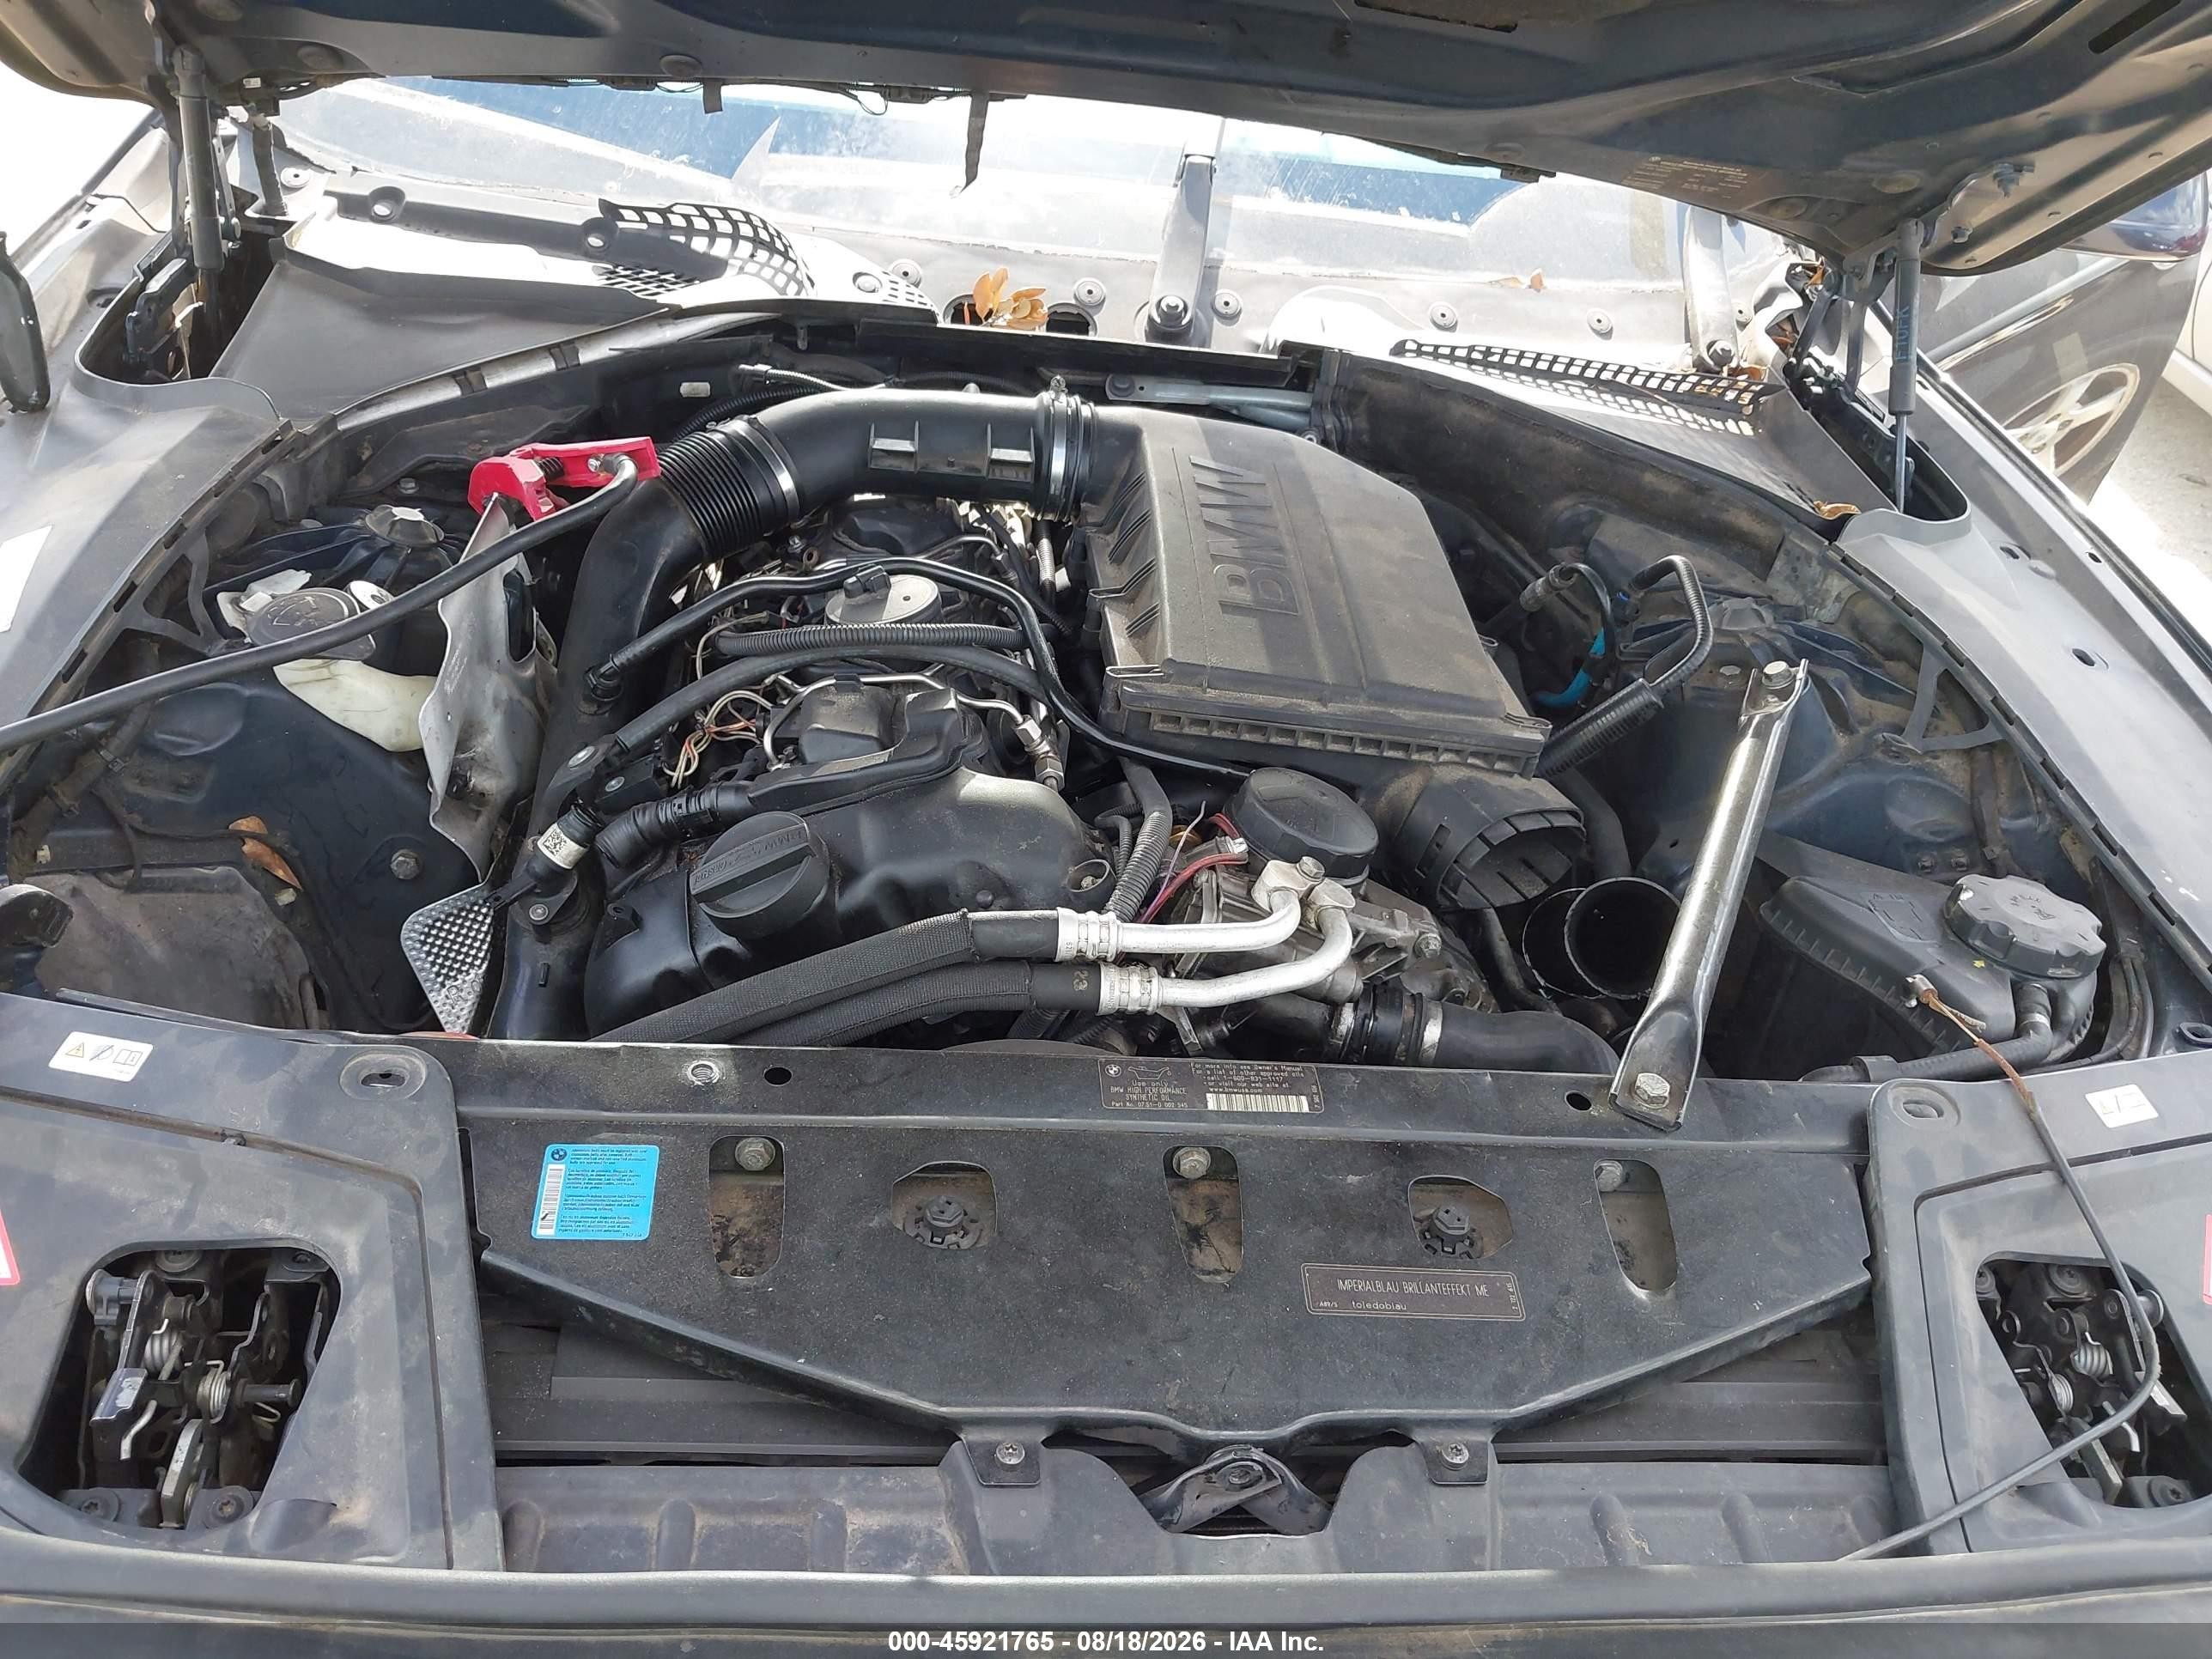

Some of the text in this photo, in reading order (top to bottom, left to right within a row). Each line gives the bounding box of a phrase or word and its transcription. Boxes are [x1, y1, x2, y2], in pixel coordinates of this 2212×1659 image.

[1188, 454, 1299, 617] BMW
[1145, 1086, 1188, 1095] PERFORMANCE
[1336, 1277, 1490, 1297] IMPERIALBLAU BRILLANTEFFEKT ME
[1352, 1299, 1407, 1311] toledoblau
